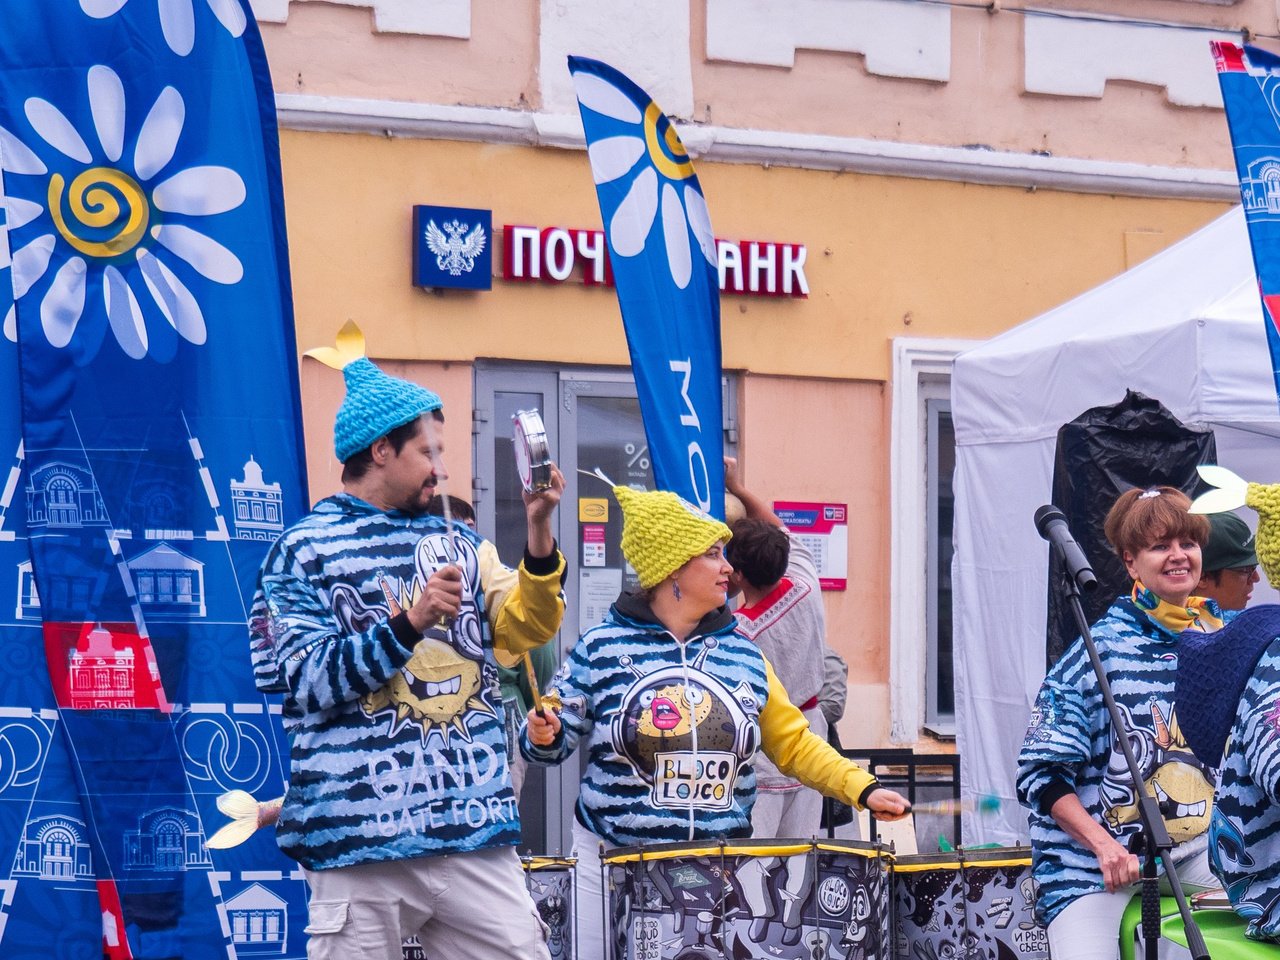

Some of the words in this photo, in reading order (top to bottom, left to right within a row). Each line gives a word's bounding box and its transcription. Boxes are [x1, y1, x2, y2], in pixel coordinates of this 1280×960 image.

[510, 226, 606, 281] ПОЧ
[717, 240, 811, 295] АНК
[451, 796, 520, 829] FORT
[635, 928, 659, 941] LOUD
[1024, 930, 1046, 943] РЫБ
[1019, 940, 1048, 953] СЪЕСТ
